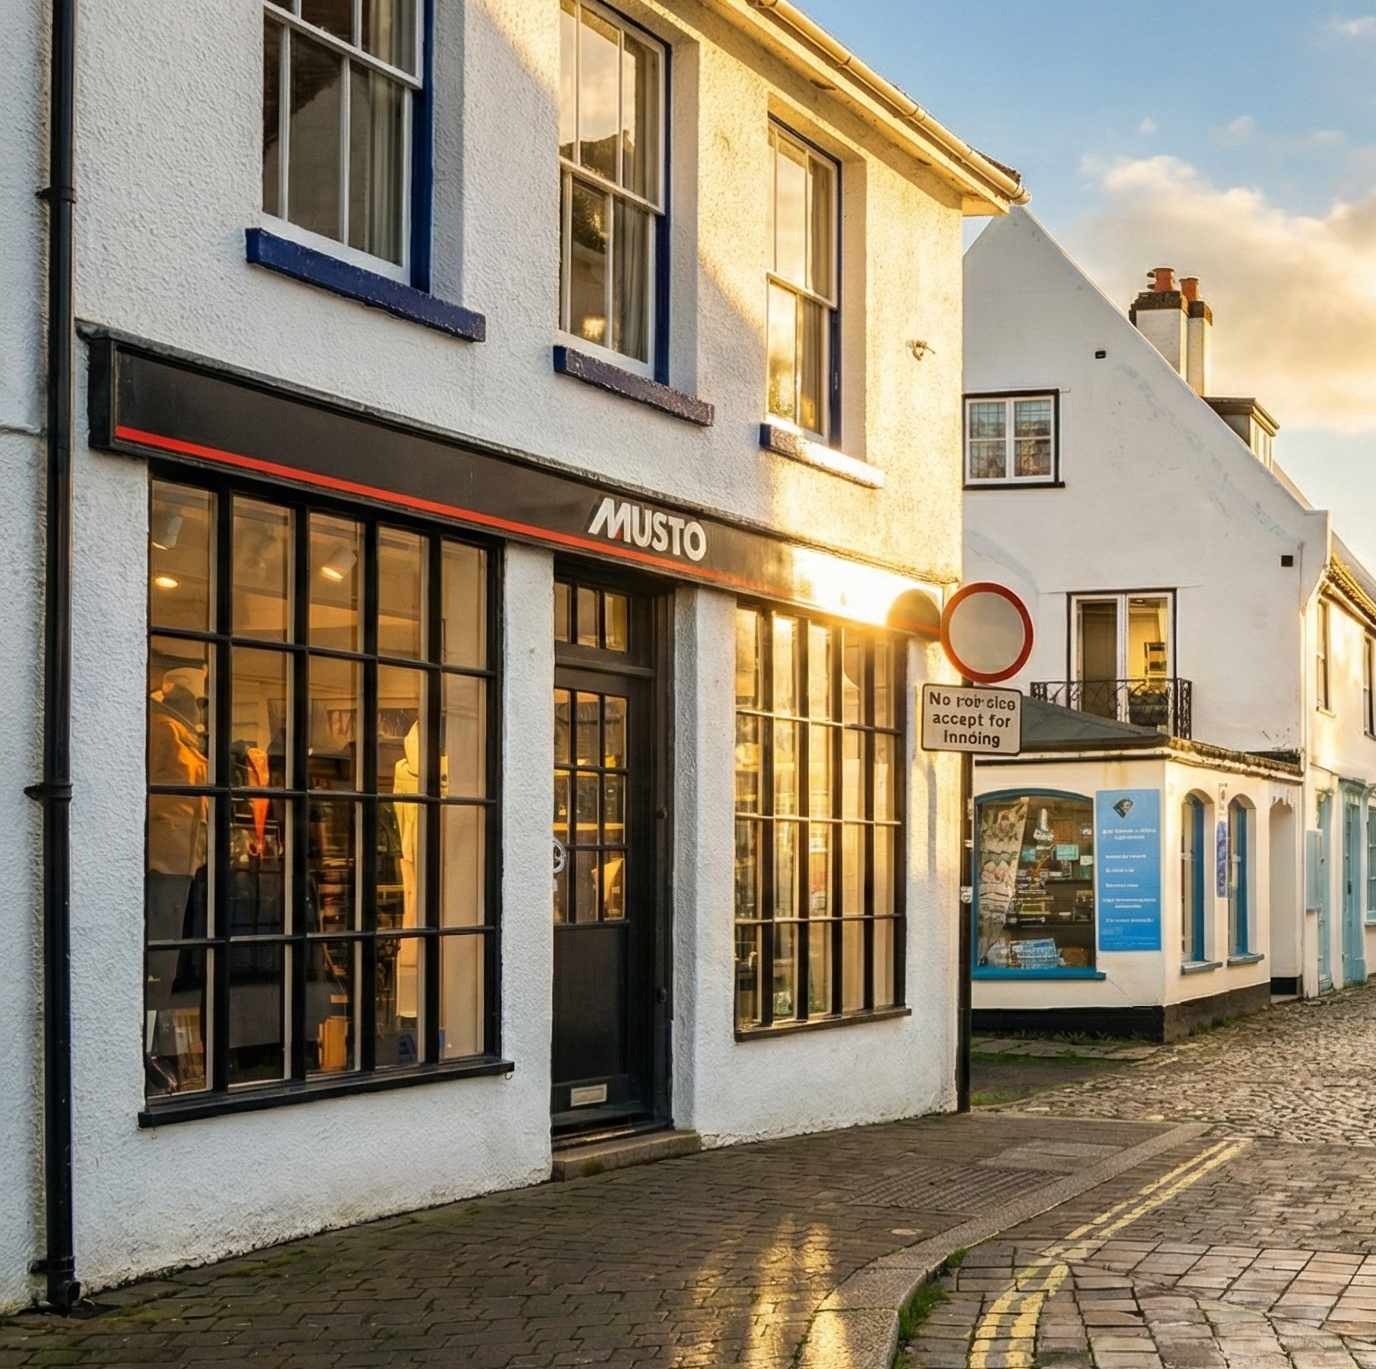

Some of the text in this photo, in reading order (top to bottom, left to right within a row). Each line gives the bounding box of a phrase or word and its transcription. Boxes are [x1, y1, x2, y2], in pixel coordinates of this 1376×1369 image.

[587, 497, 707, 562] MUSTO
[929, 691, 951, 706] No
[932, 713, 1011, 729] accept for
